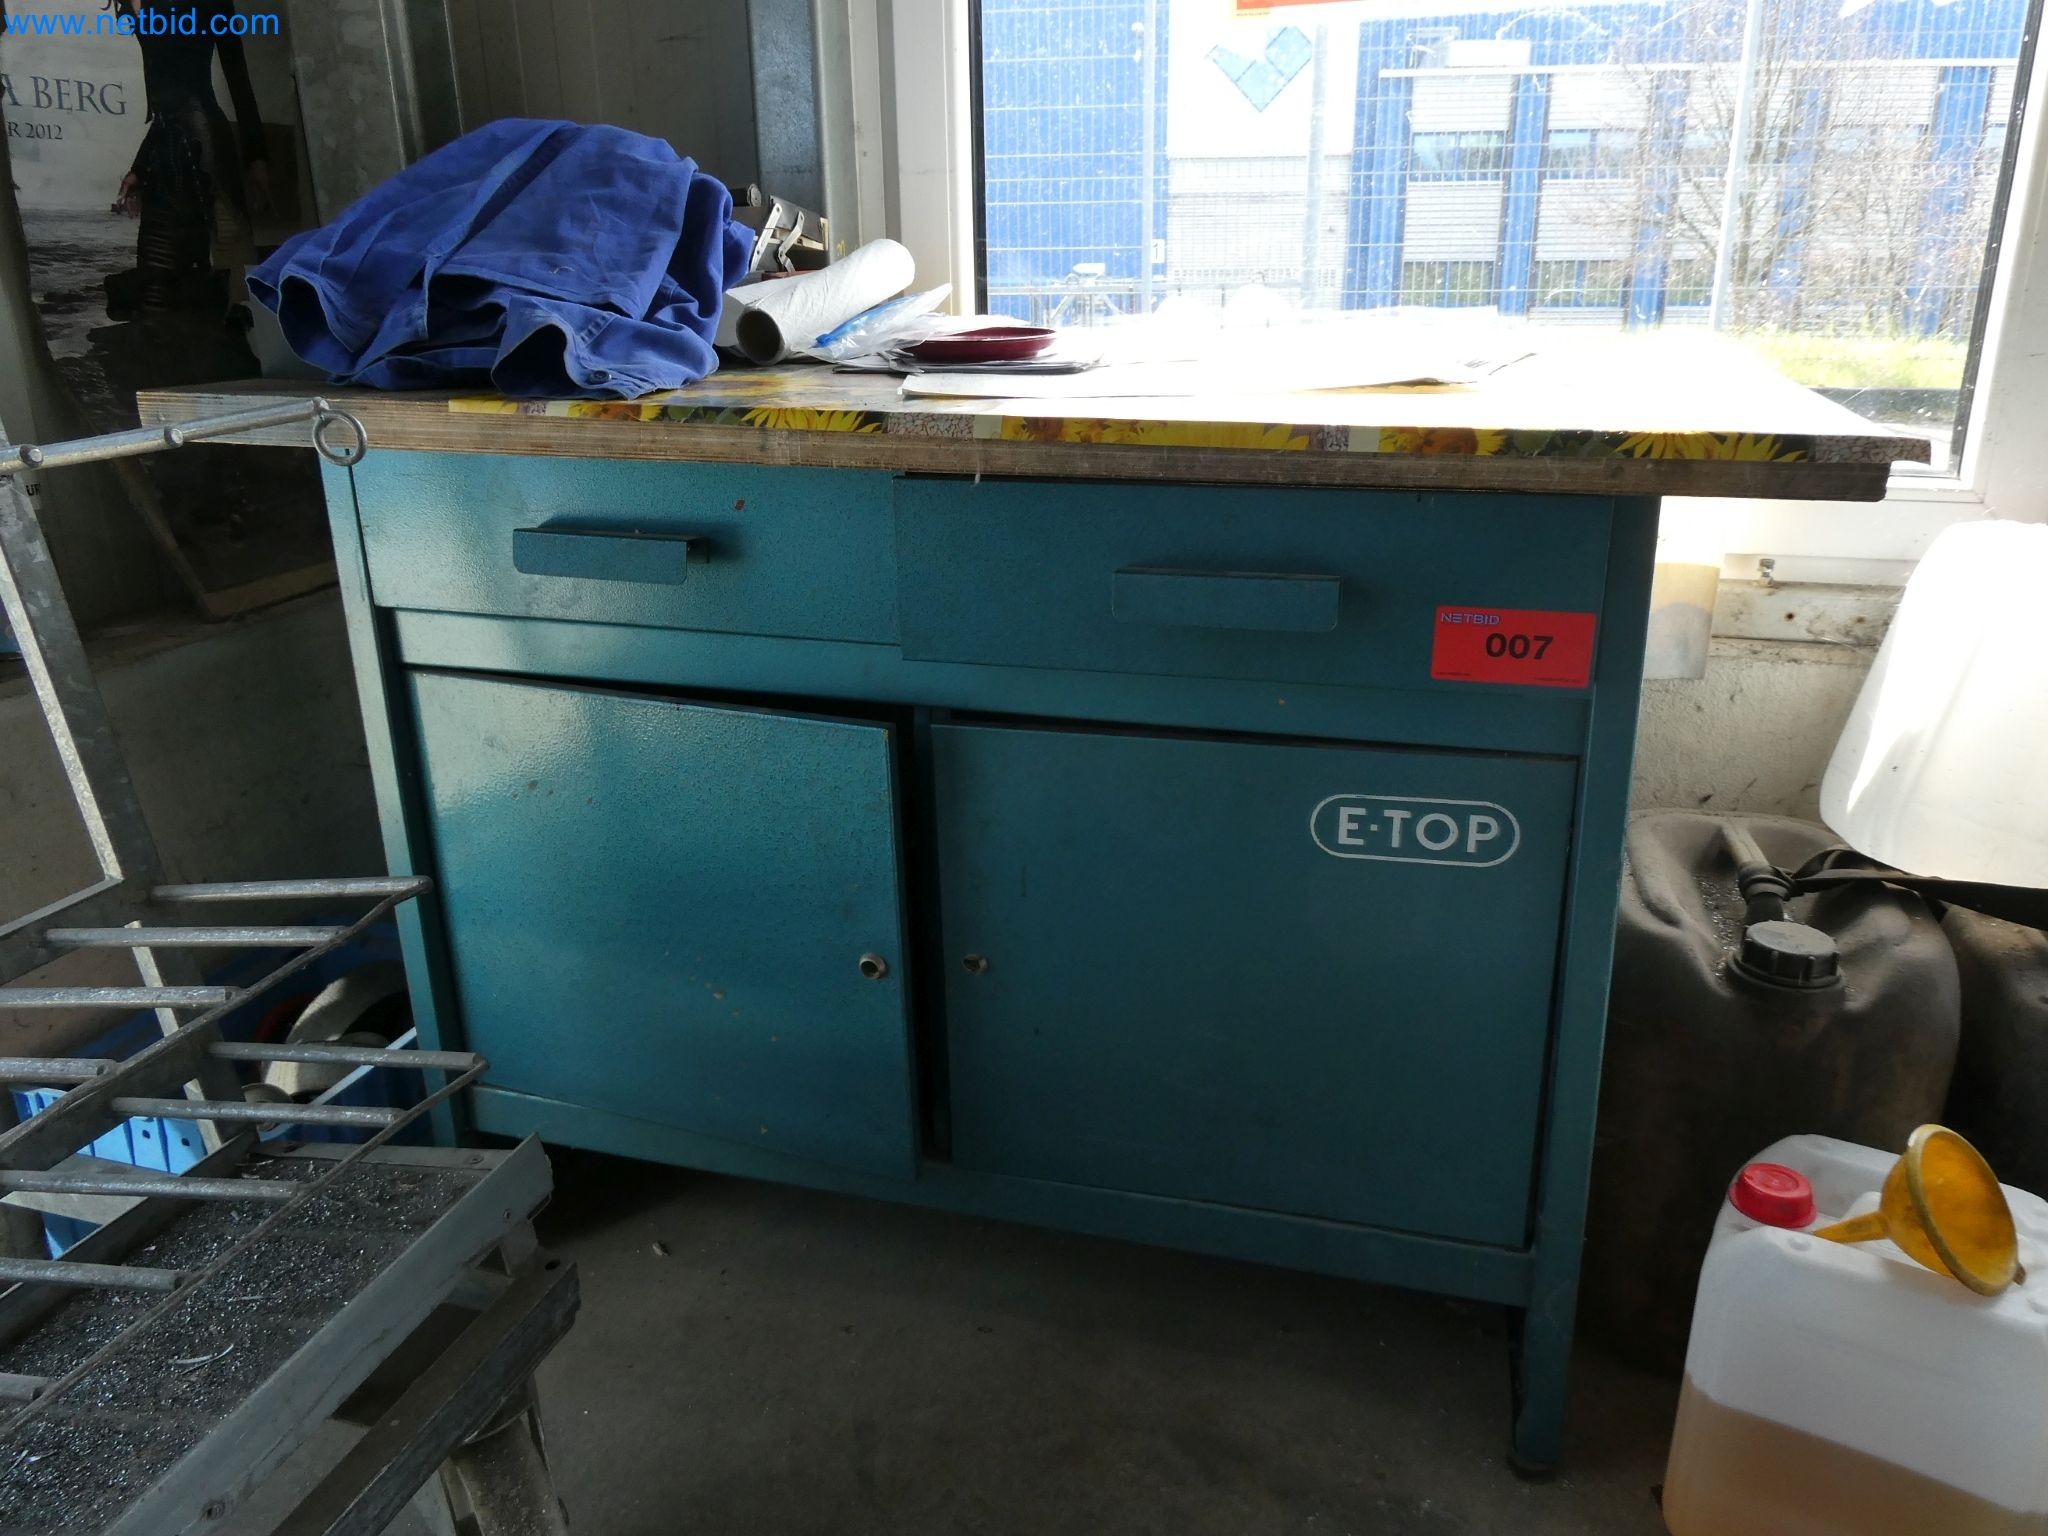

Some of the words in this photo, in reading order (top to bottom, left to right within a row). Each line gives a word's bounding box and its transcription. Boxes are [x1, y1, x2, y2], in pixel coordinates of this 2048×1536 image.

[30, 76, 127, 115] BERG
[25, 122, 63, 140] 2012
[1440, 613, 1500, 625] NETBID
[1485, 633, 1553, 660] 007
